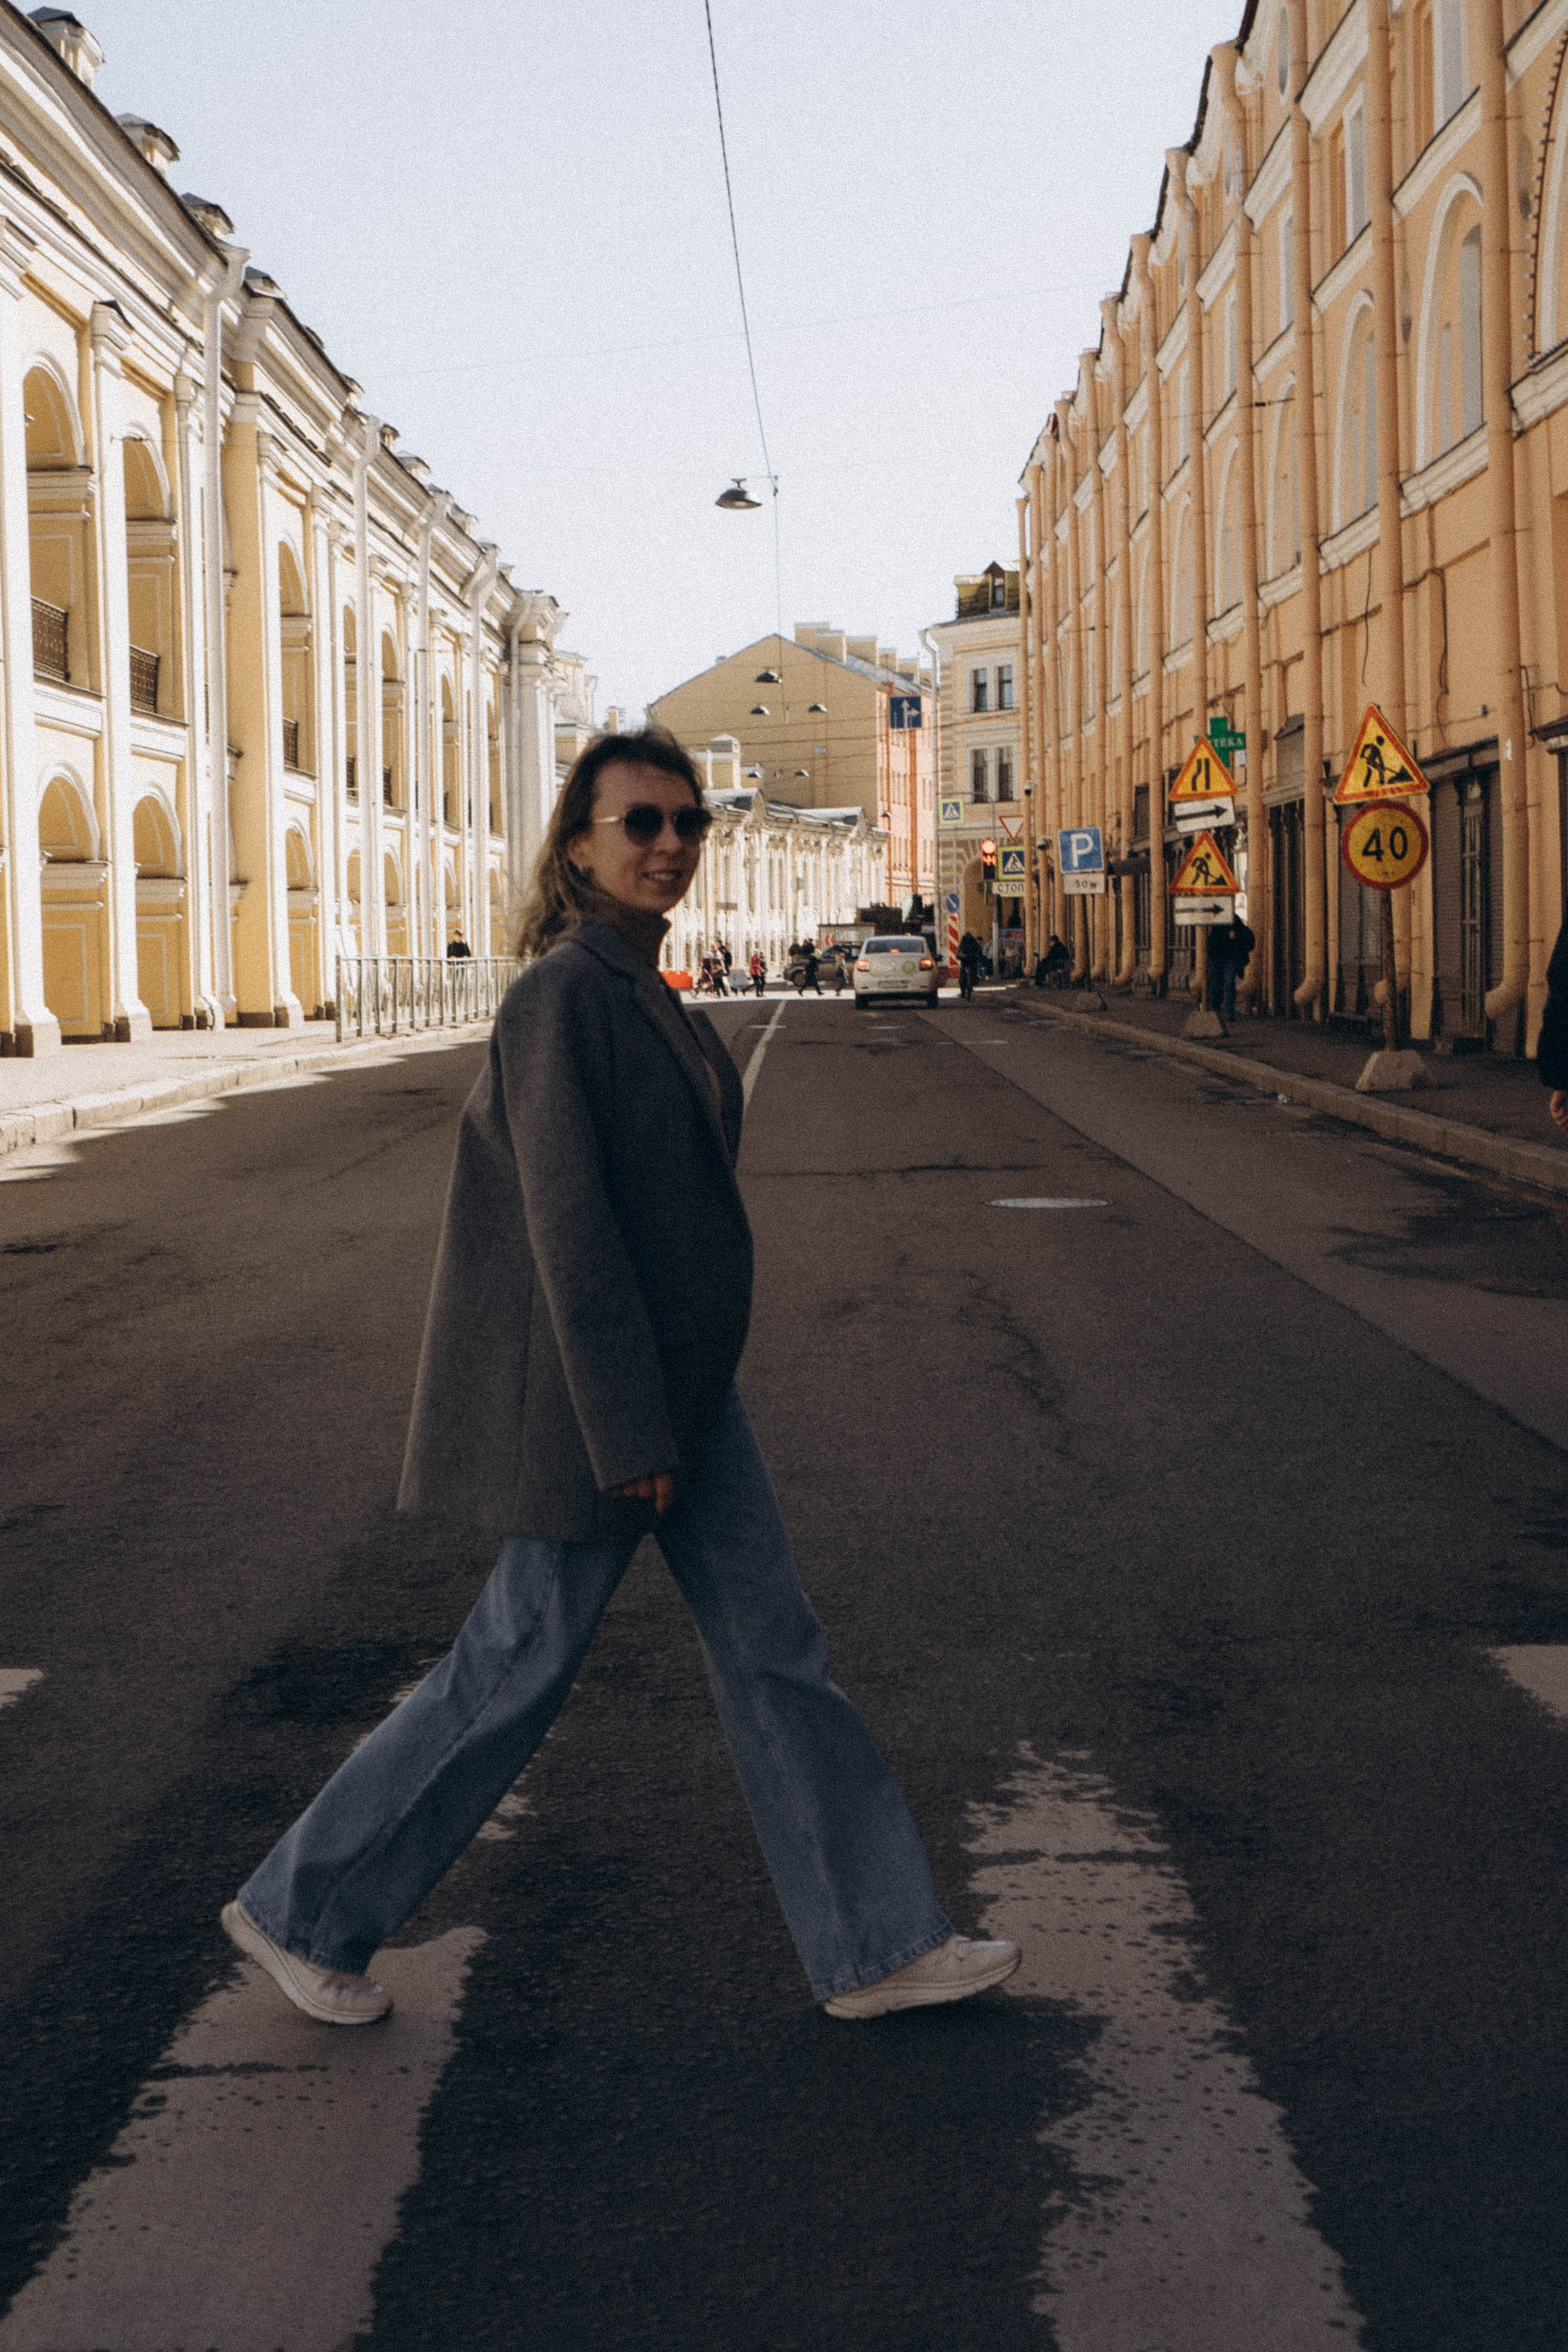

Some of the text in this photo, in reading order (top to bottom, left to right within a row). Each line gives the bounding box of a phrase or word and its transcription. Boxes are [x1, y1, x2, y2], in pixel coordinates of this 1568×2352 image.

[1212, 737, 1243, 747] ТЕКА
[1362, 827, 1408, 862] 40
[1071, 833, 1094, 867] P
[998, 884, 1023, 892] СТОП
[1075, 880, 1088, 888] 50
